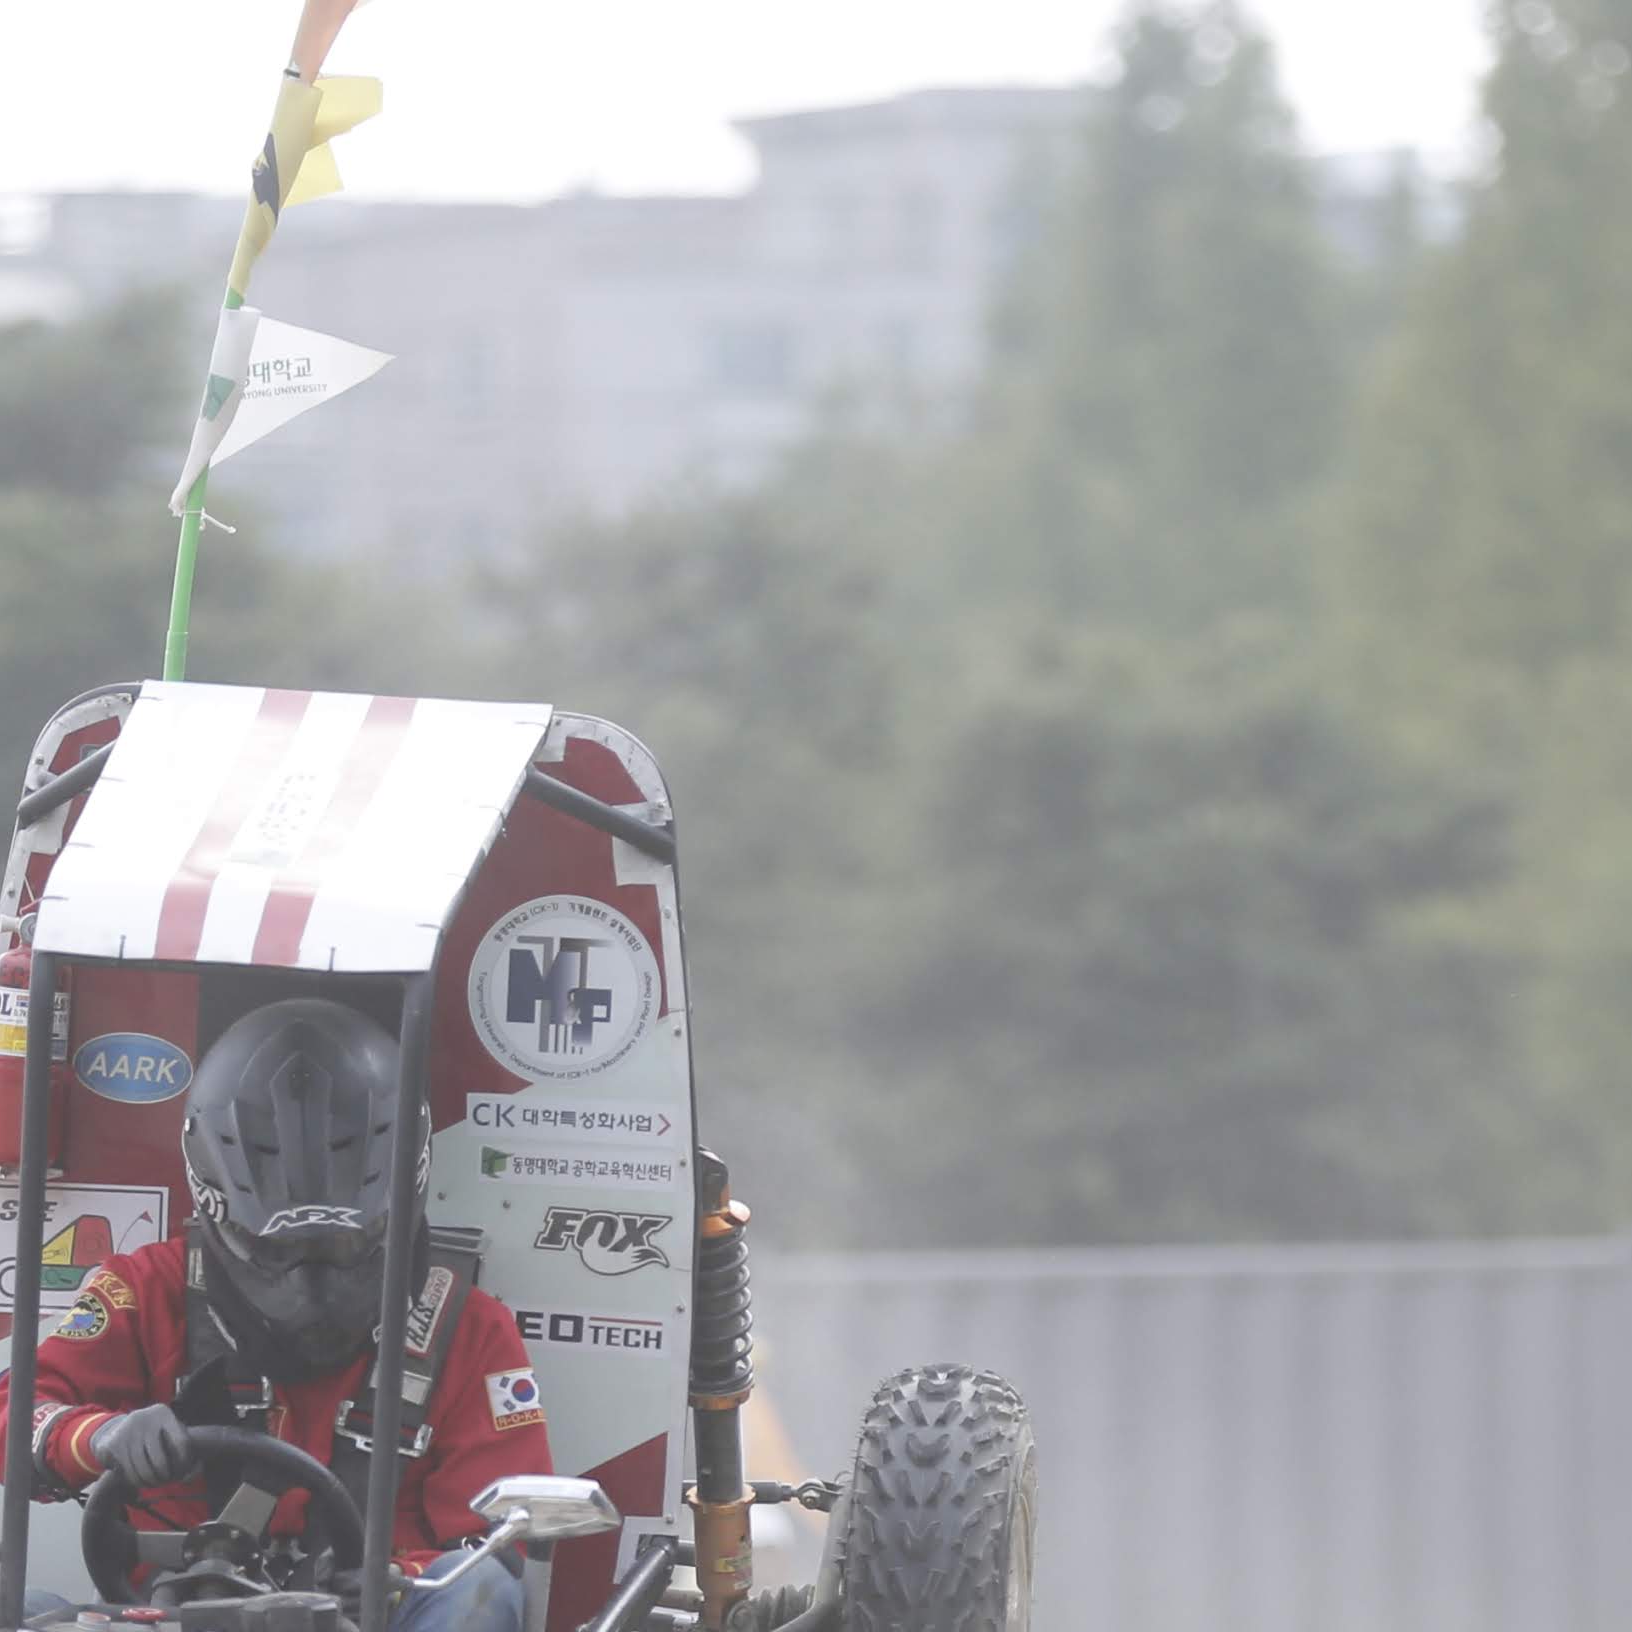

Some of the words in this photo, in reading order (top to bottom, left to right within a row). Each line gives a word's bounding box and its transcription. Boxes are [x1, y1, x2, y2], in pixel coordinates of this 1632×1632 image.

[274, 383, 328, 397] UNIVERSITY
[87, 1051, 179, 1085] AARK
[472, 1102, 516, 1128] CK
[521, 1107, 653, 1133] 대학특성화사업
[512, 1156, 569, 1176] 동명대학교
[571, 1159, 673, 1182] 공학교육혁신센터
[534, 1205, 673, 1260] FOX
